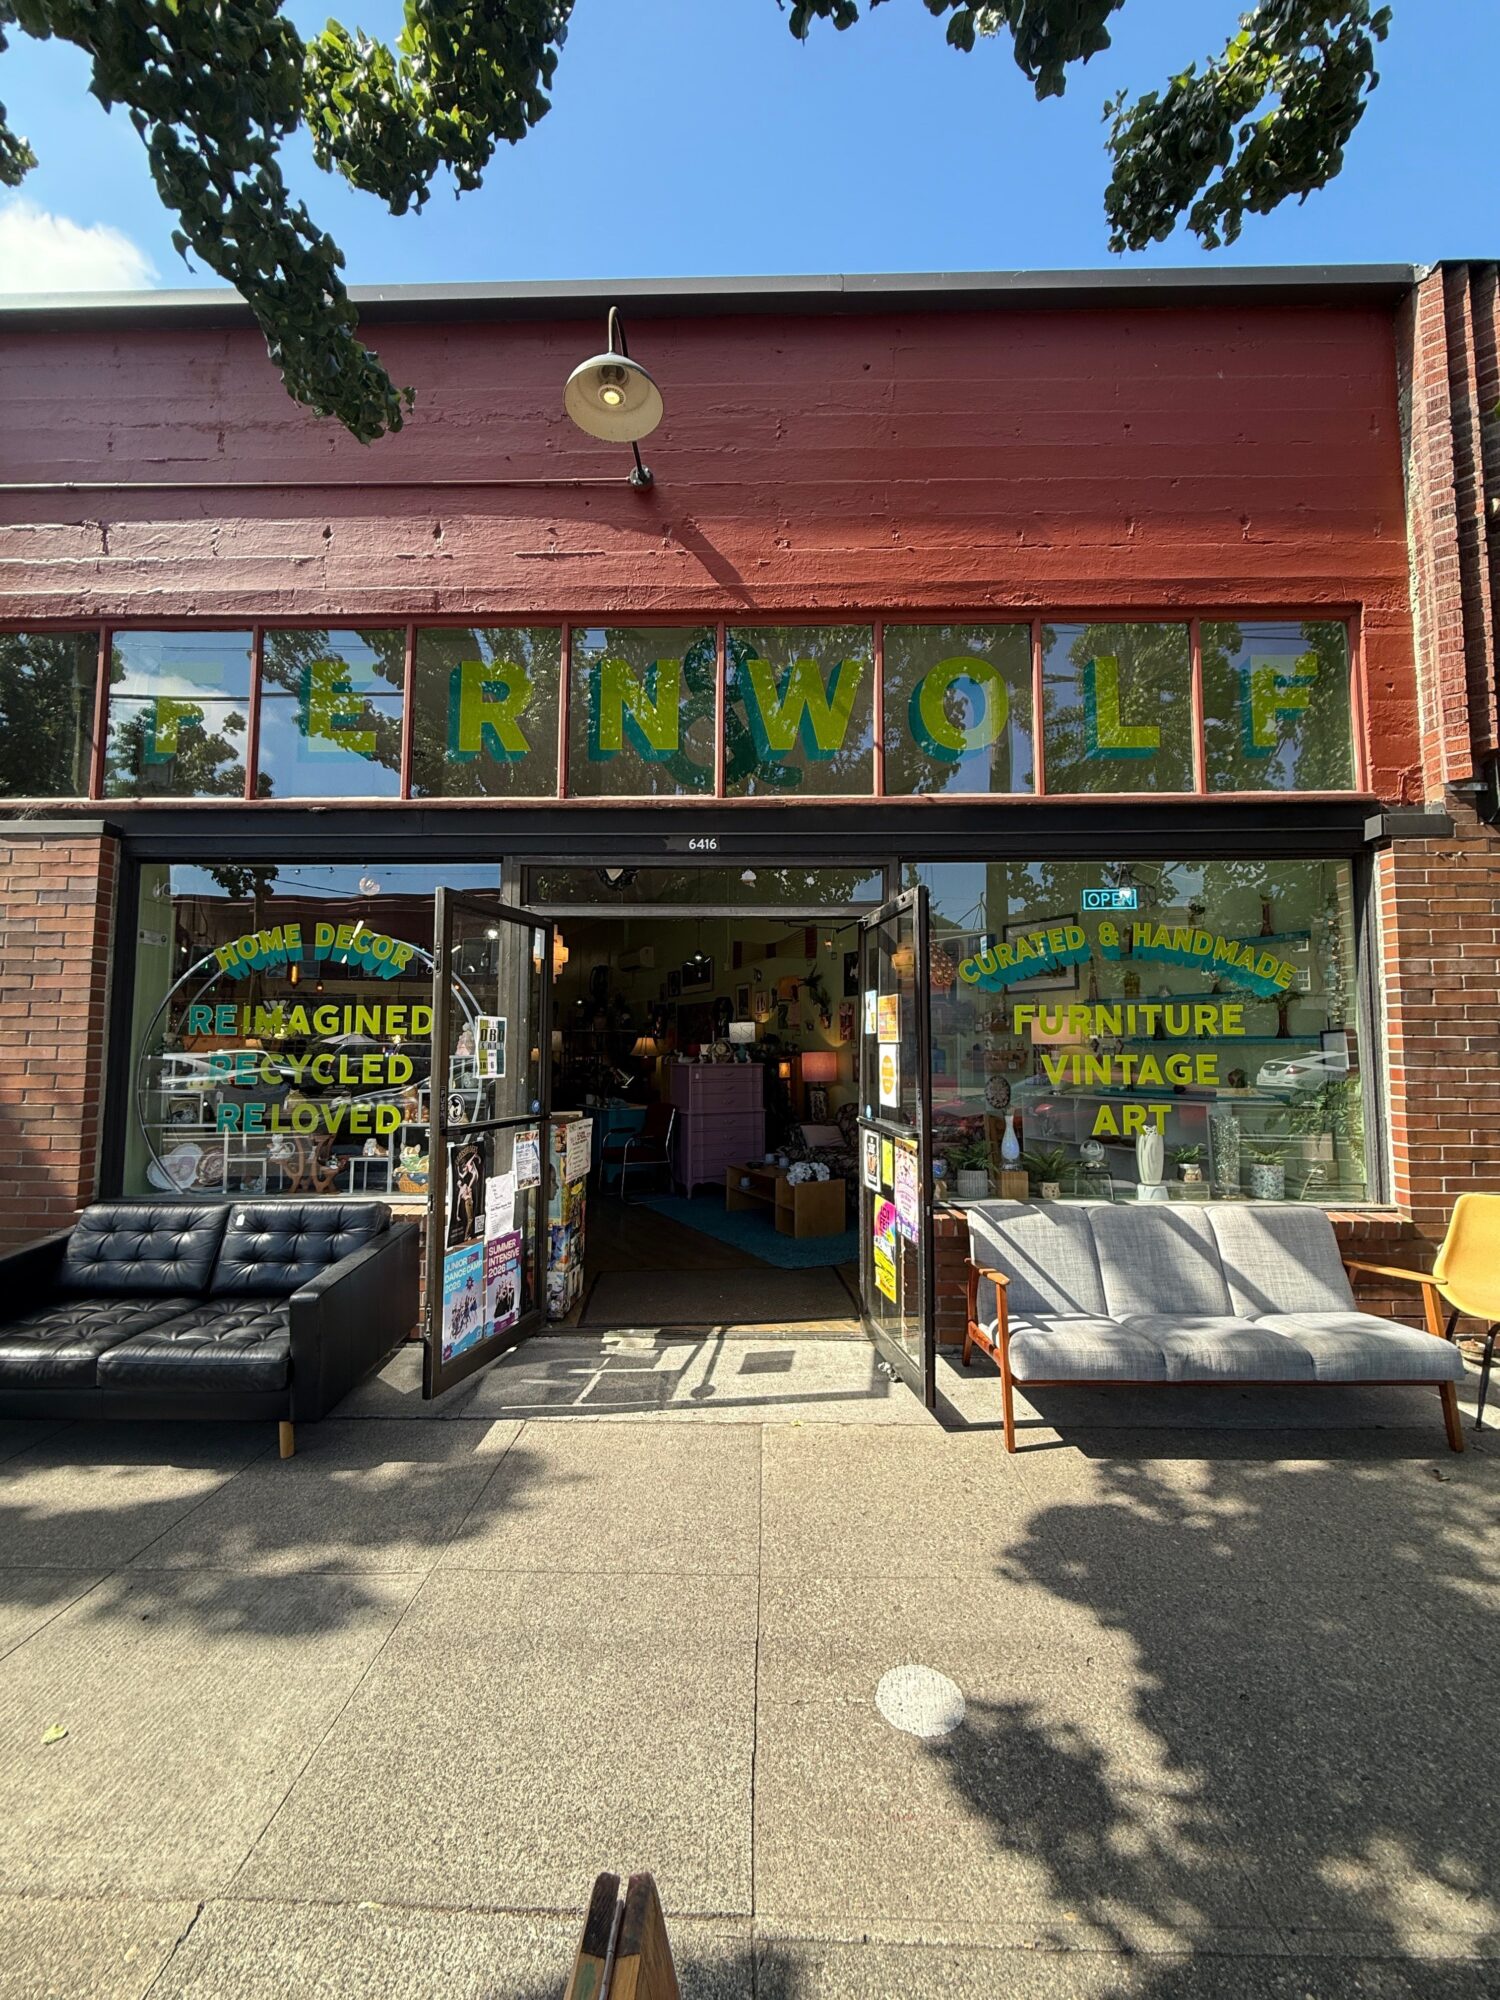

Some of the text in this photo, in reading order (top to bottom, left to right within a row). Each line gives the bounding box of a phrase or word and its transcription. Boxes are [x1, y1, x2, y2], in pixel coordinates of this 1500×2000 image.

[146, 659, 680, 762] FERN
[740, 655, 1318, 761] WOLF
[688, 838, 718, 850] 6416
[1087, 891, 1134, 907] OPEN
[214, 922, 414, 977] HOME DECOR
[958, 921, 1298, 990] CURATED & HANDMADE
[188, 1004, 433, 1036] REIMAGINED
[1013, 1004, 1246, 1036] FURNITURE
[209, 1054, 414, 1085] RECYCLED
[1041, 1054, 1220, 1086] VINTAGE
[217, 1103, 402, 1135] RELOVED
[1092, 1104, 1172, 1137] ART
[488, 1247, 520, 1267] INTENSIVE
[489, 1239, 517, 1256] SUMMER
[445, 1257, 468, 1274] JUNIOR
[445, 1260, 483, 1283] DANCE CAMP
[489, 1263, 506, 1278] 2026
[445, 1279, 461, 1294] 2026
